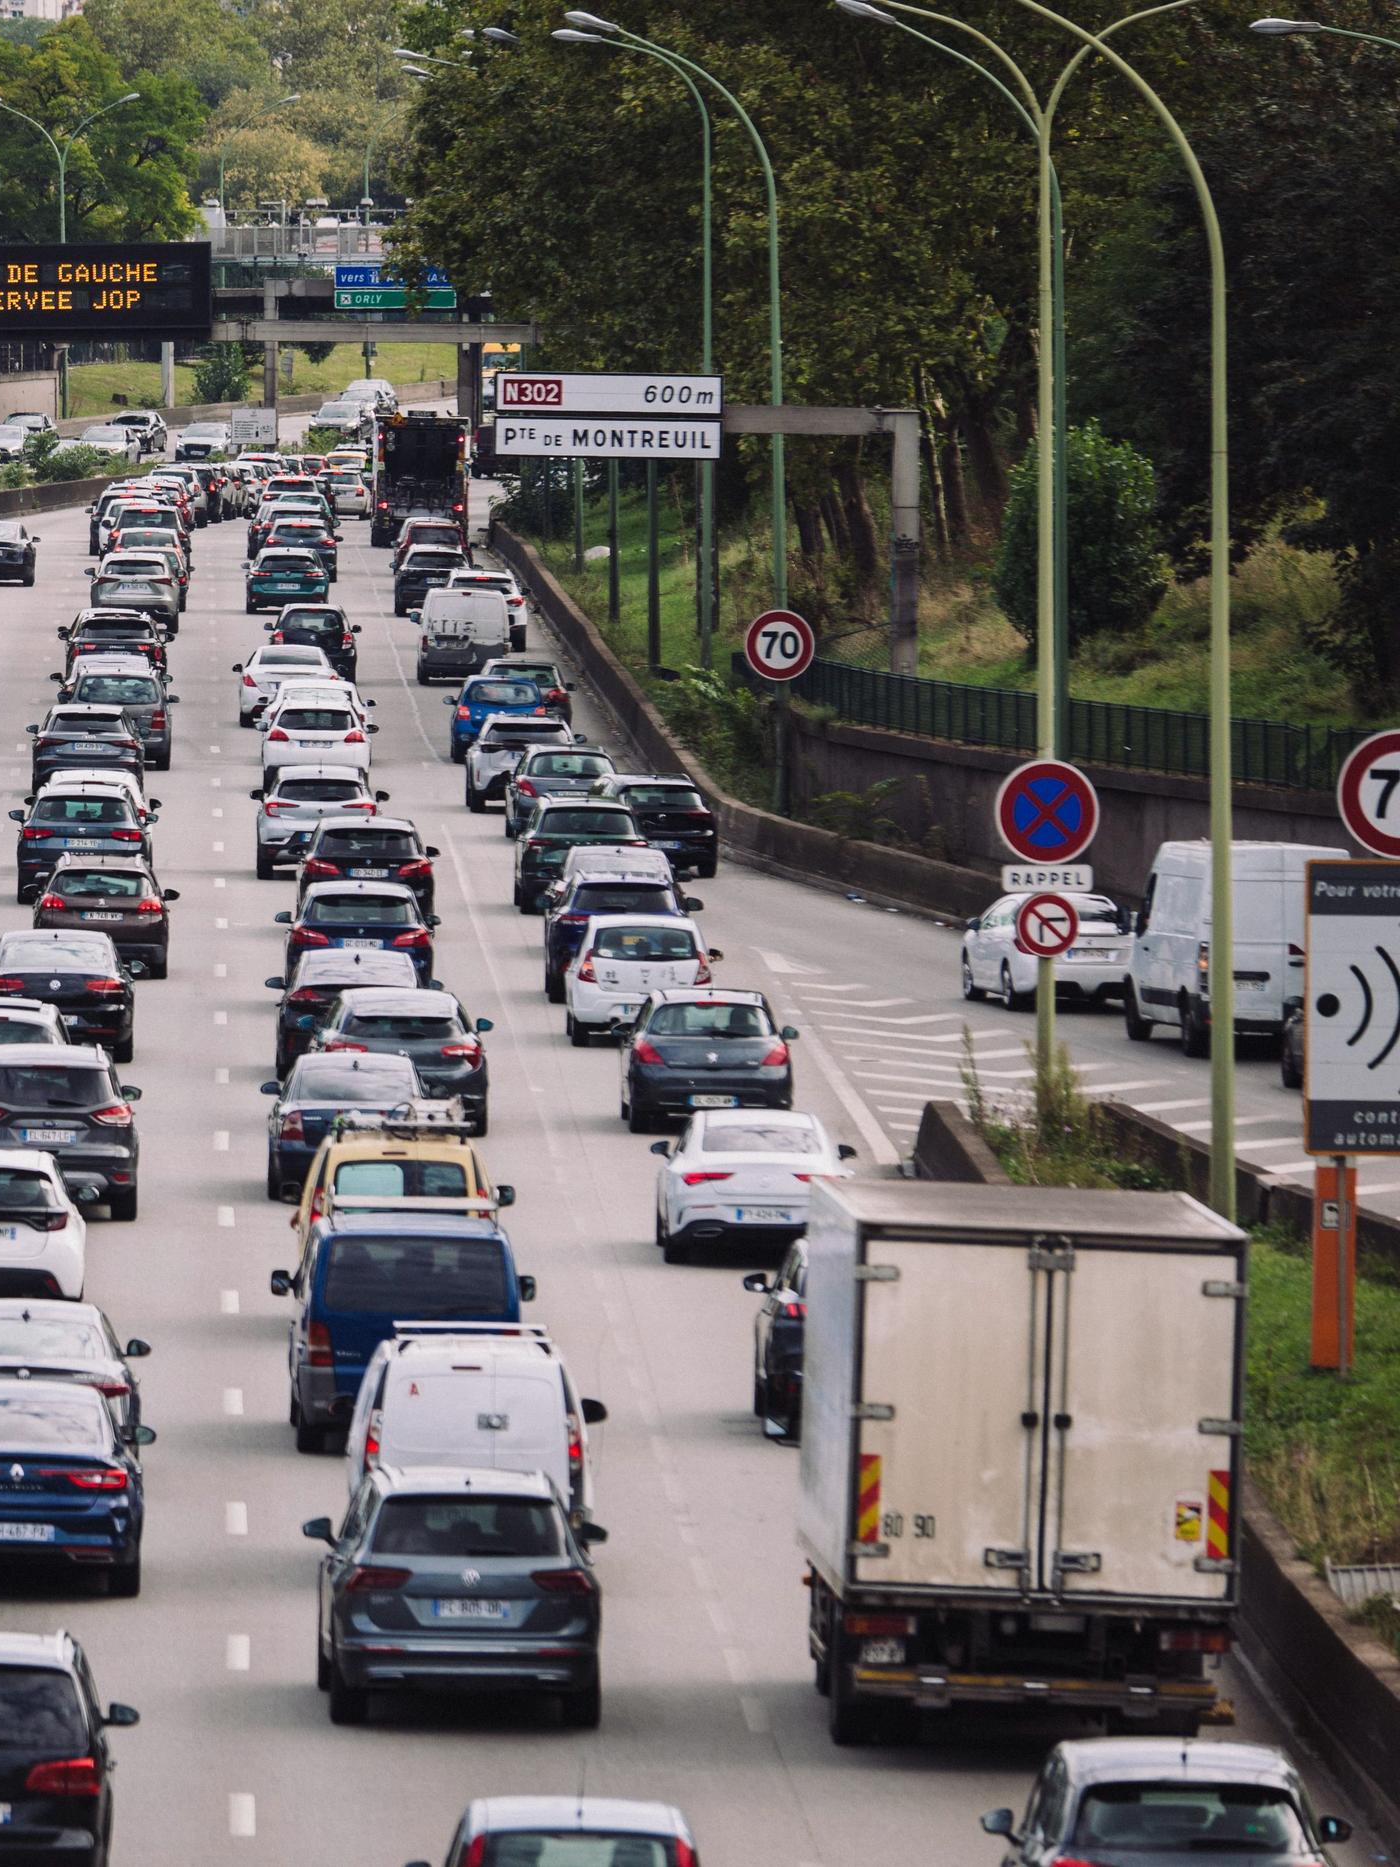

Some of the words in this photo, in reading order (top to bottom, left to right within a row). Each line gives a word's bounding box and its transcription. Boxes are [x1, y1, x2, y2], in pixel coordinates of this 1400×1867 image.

[7, 264, 39, 283] DE
[58, 263, 158, 283] GAUCHE
[93, 290, 141, 310] JOP
[355, 295, 383, 304] ORLY
[505, 383, 560, 402] N302
[544, 434, 562, 446] DE
[572, 429, 712, 449] MONTREUIL
[761, 630, 799, 660] 70
[1011, 872, 1083, 886] RAPPEL
[1314, 881, 1354, 897] Pour
[408, 1381, 420, 1396] A
[914, 1514, 936, 1539] 90
